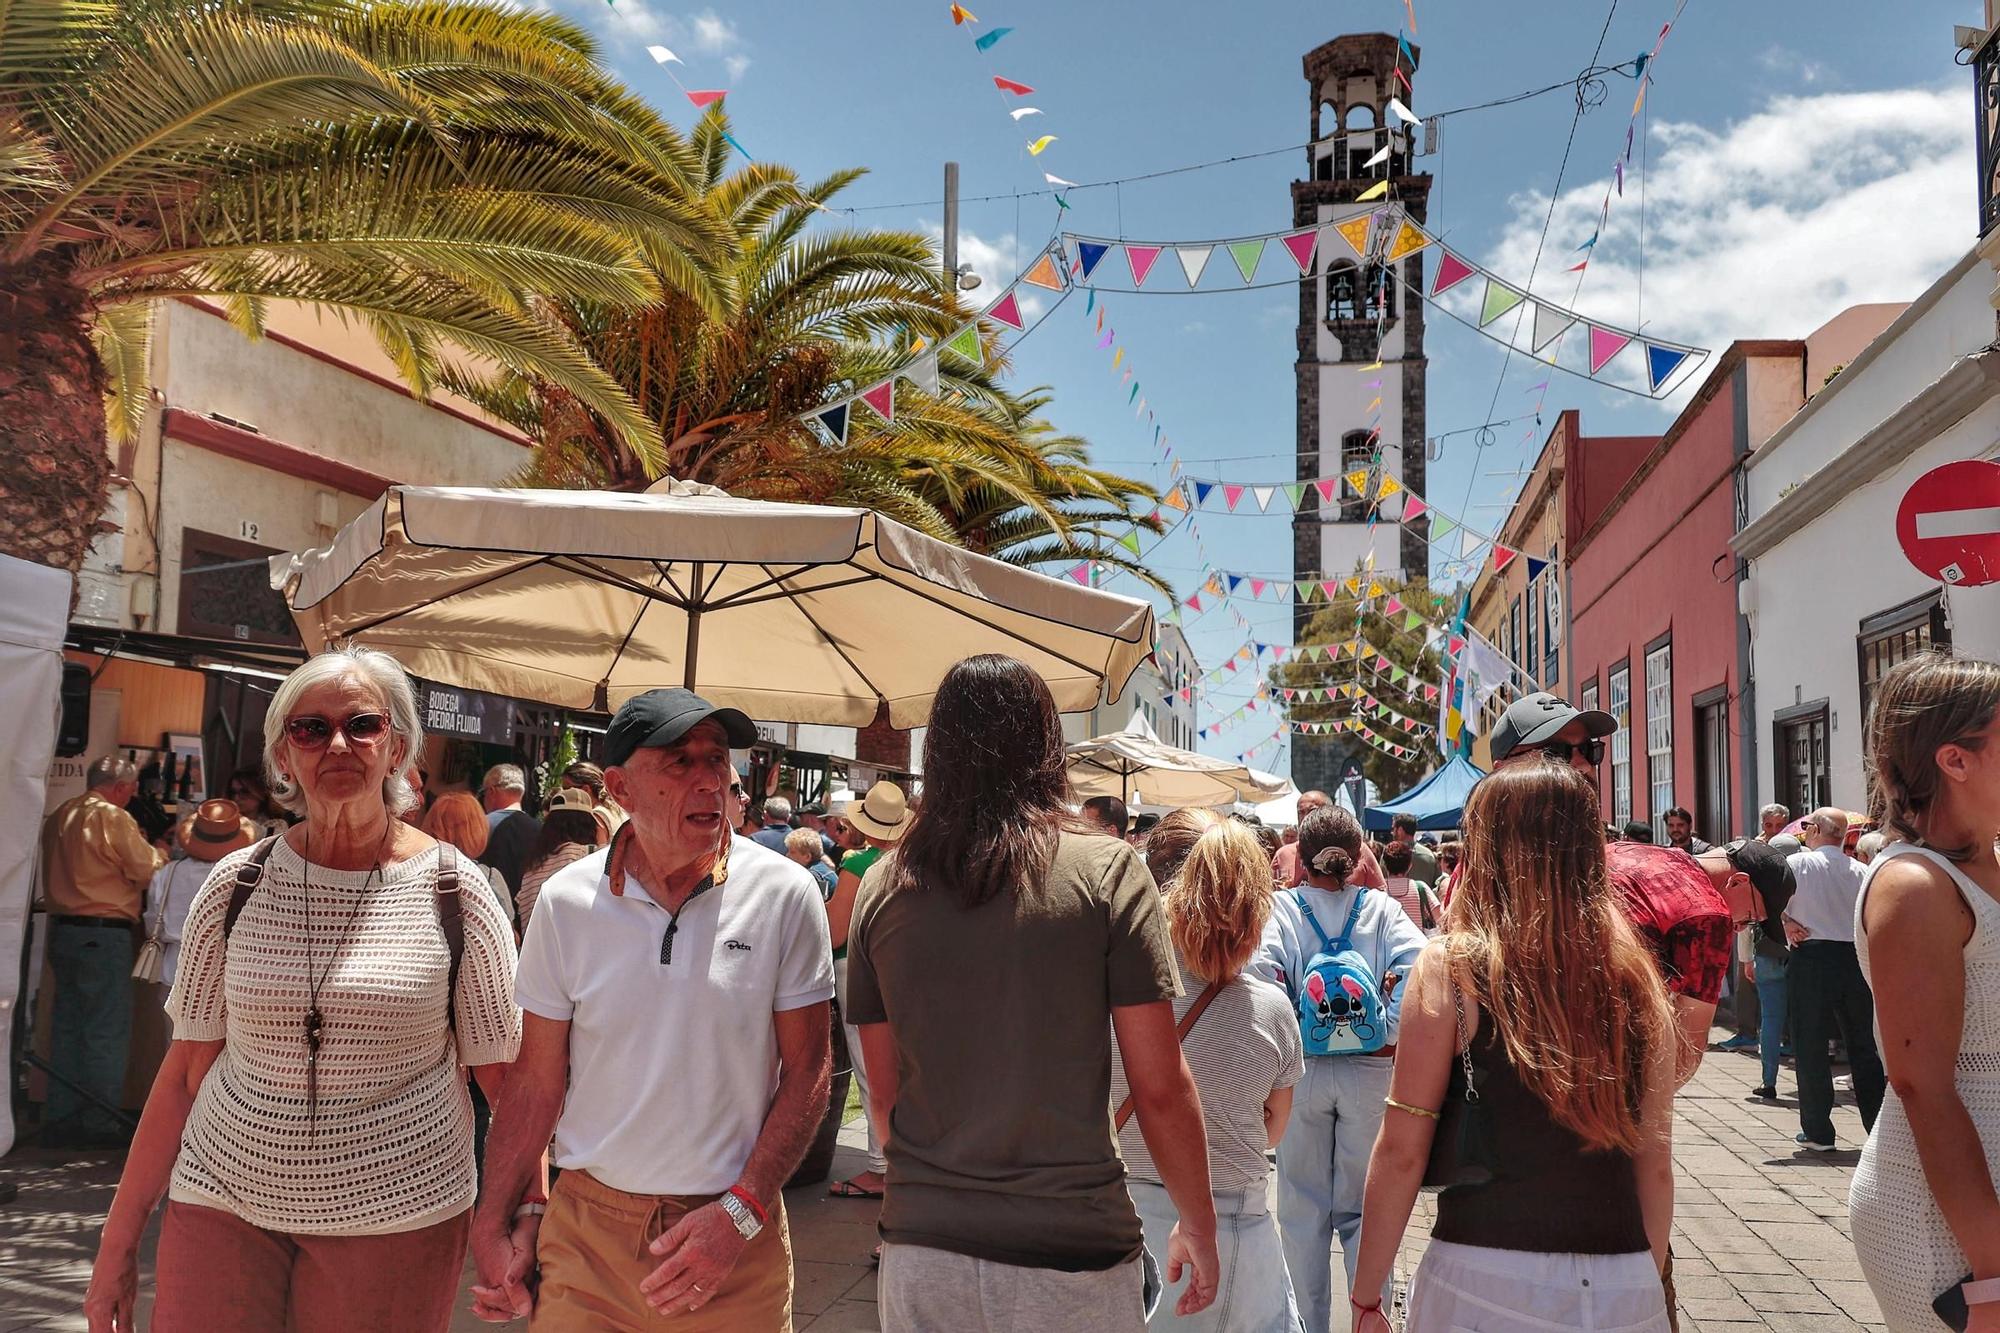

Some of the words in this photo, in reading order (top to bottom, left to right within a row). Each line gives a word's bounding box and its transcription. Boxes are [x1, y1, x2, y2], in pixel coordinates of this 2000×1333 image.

[241, 520, 259, 540] 12
[429, 690, 459, 713] BODEGA
[428, 709, 455, 731] PIEDRA
[456, 714, 481, 735] FLUIDA
